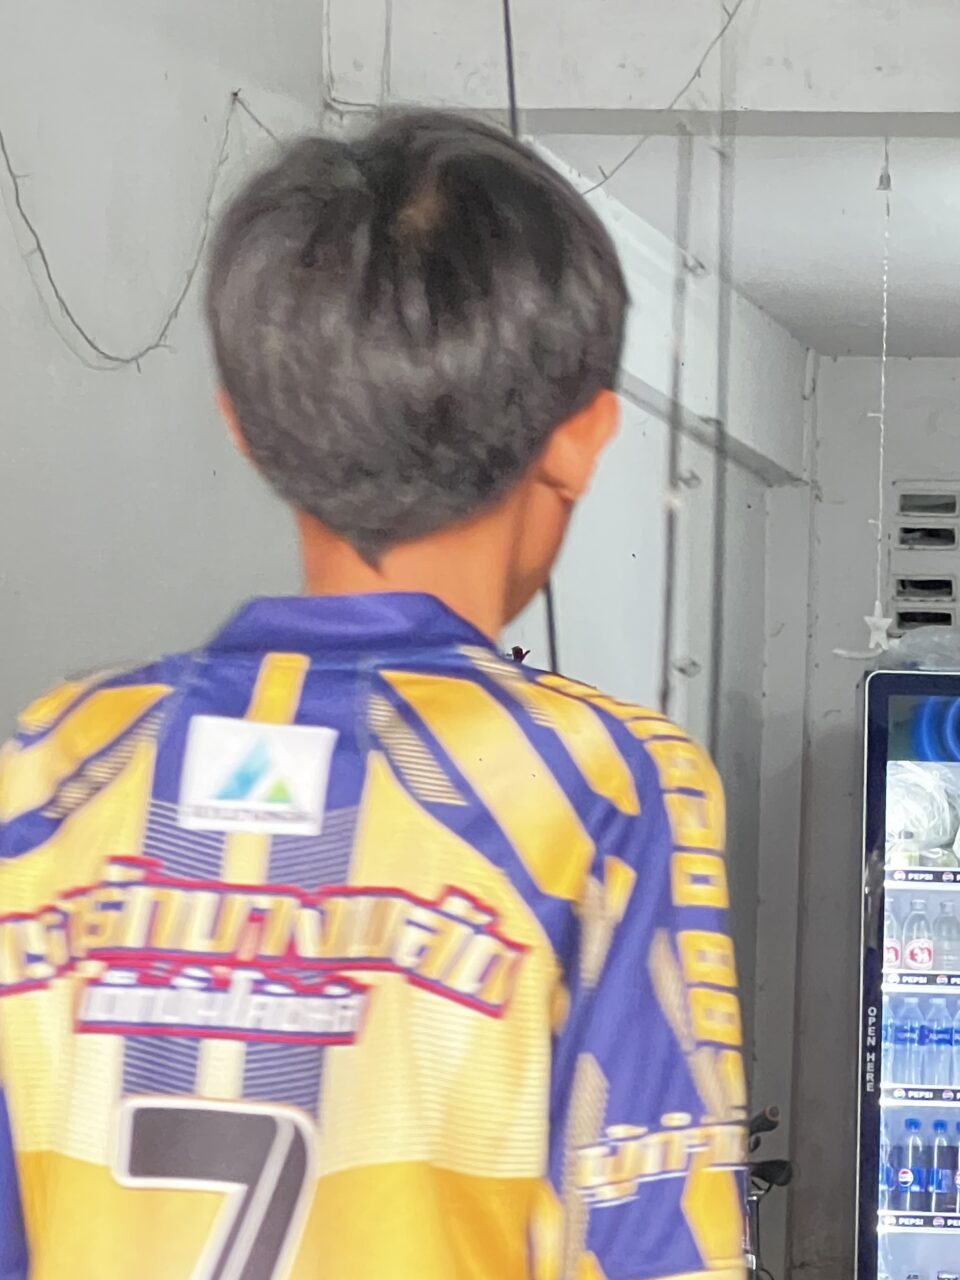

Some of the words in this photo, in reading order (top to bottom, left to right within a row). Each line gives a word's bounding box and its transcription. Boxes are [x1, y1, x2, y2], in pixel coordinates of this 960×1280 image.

[907, 873, 934, 881] PEPSI
[902, 976, 927, 984] PEPSI
[866, 1006, 877, 1046] OPEN
[865, 1052, 876, 1092] HERE
[907, 1091, 933, 1099] PEPSI
[898, 1217, 924, 1225] PEPSI
